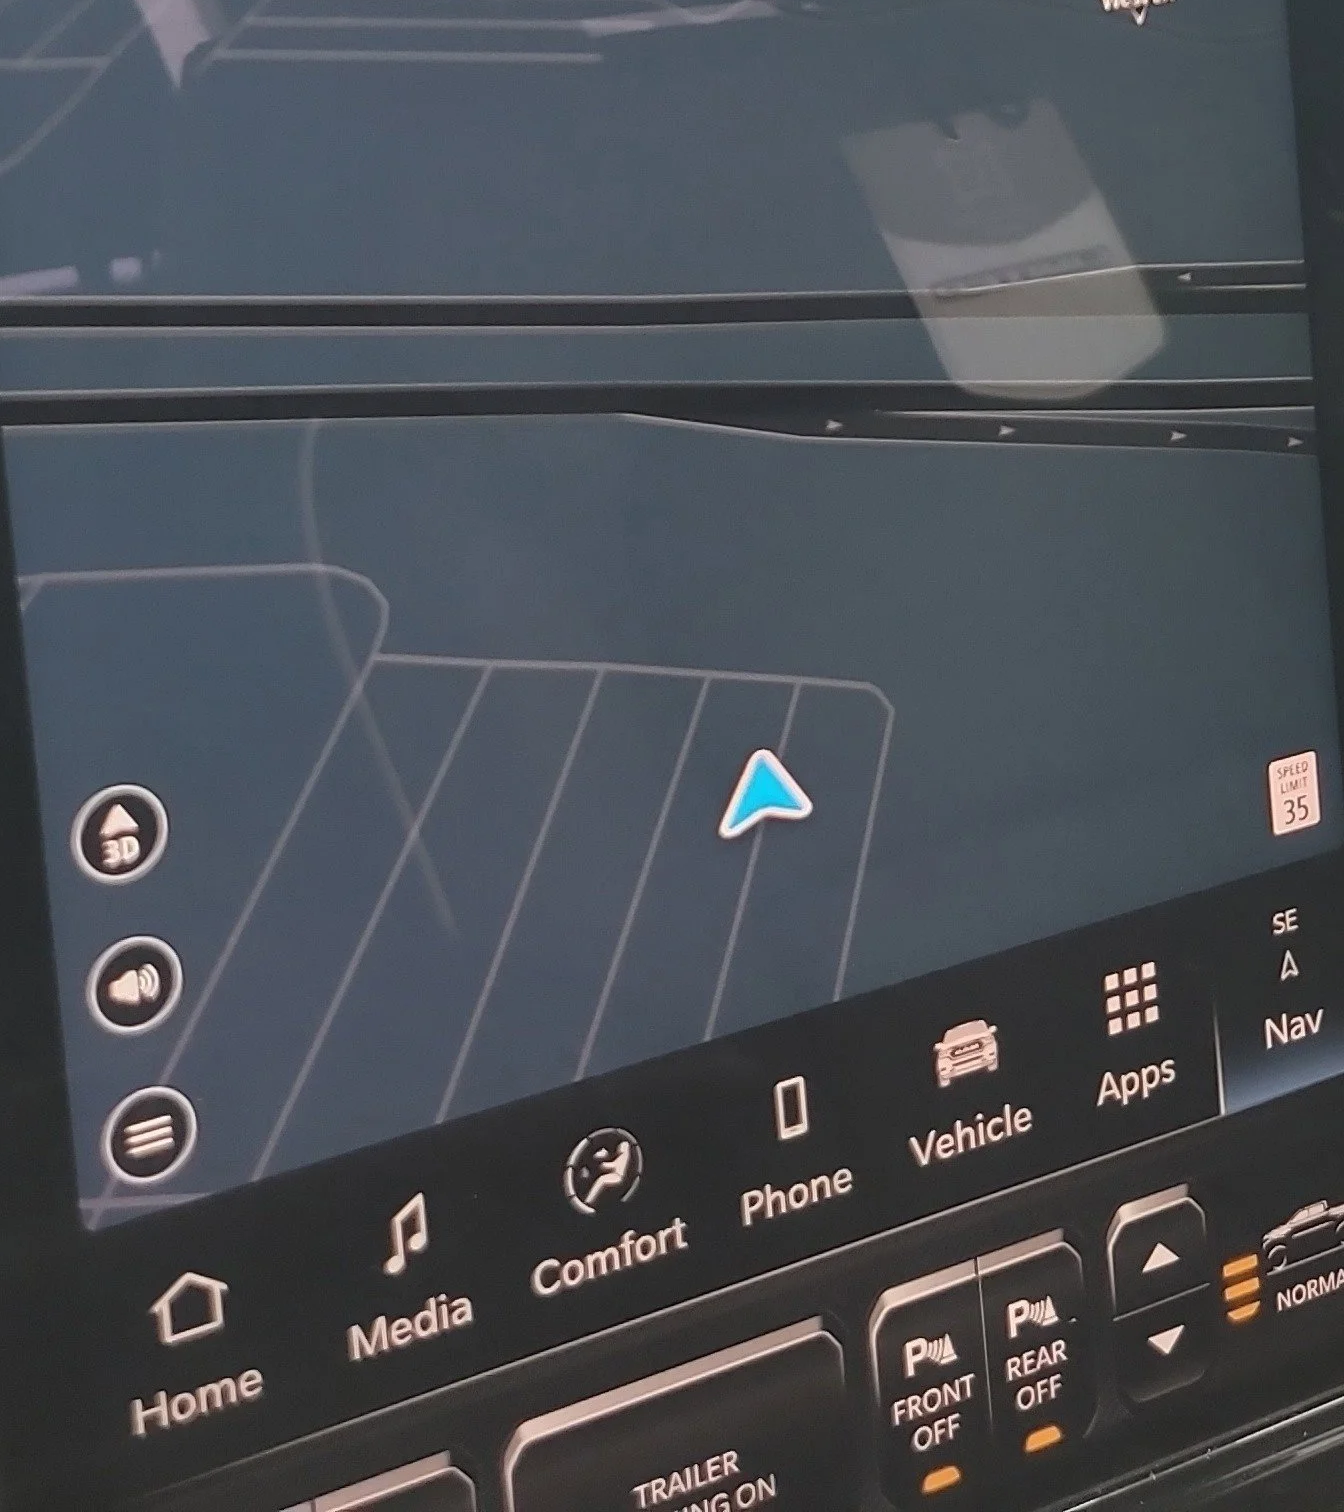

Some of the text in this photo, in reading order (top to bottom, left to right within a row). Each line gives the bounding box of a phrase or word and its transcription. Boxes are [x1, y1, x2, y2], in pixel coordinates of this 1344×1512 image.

[1276, 760, 1309, 780] SPEED
[1280, 776, 1308, 794] LIMIT
[1283, 794, 1309, 826] 35
[1272, 908, 1299, 935] SE
[1265, 1008, 1325, 1050] Nav
[1096, 1057, 1177, 1107] Apps
[908, 1102, 1034, 1168] Vehicle
[740, 1165, 854, 1228] Phone
[531, 1216, 689, 1297] Comfort
[346, 1292, 475, 1361] Media
[1006, 1339, 1068, 1381] REAR
[129, 1367, 265, 1437] Home
[891, 1372, 976, 1426] FRONT
[1016, 1373, 1063, 1412] OFF
[912, 1412, 961, 1452] OFF
[630, 1449, 742, 1509] TRAILER
[736, 1473, 777, 1509] ON
